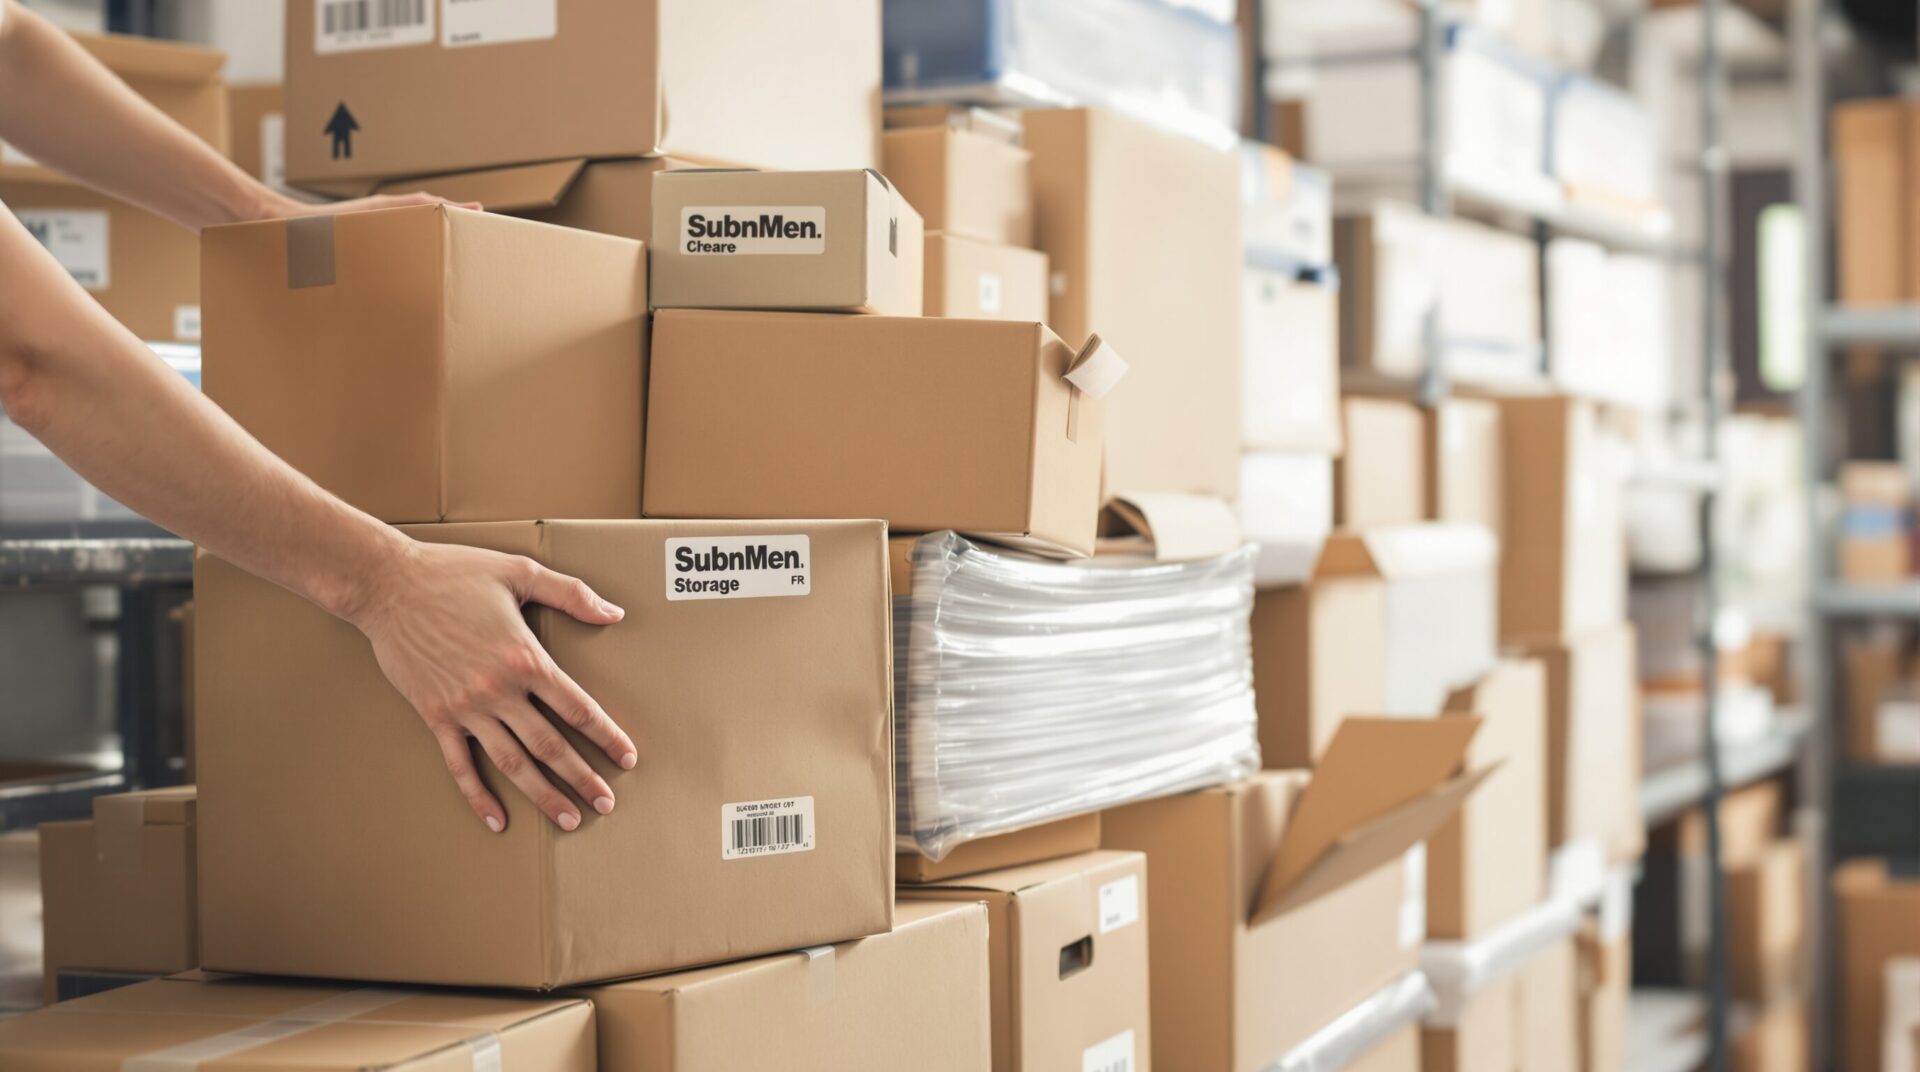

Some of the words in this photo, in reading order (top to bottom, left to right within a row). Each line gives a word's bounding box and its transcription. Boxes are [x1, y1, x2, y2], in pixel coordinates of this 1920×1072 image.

[687, 214, 822, 239] SubnMen.
[675, 544, 804, 573] SubnMen.
[674, 577, 740, 595] Storage
[791, 575, 805, 585] FR
